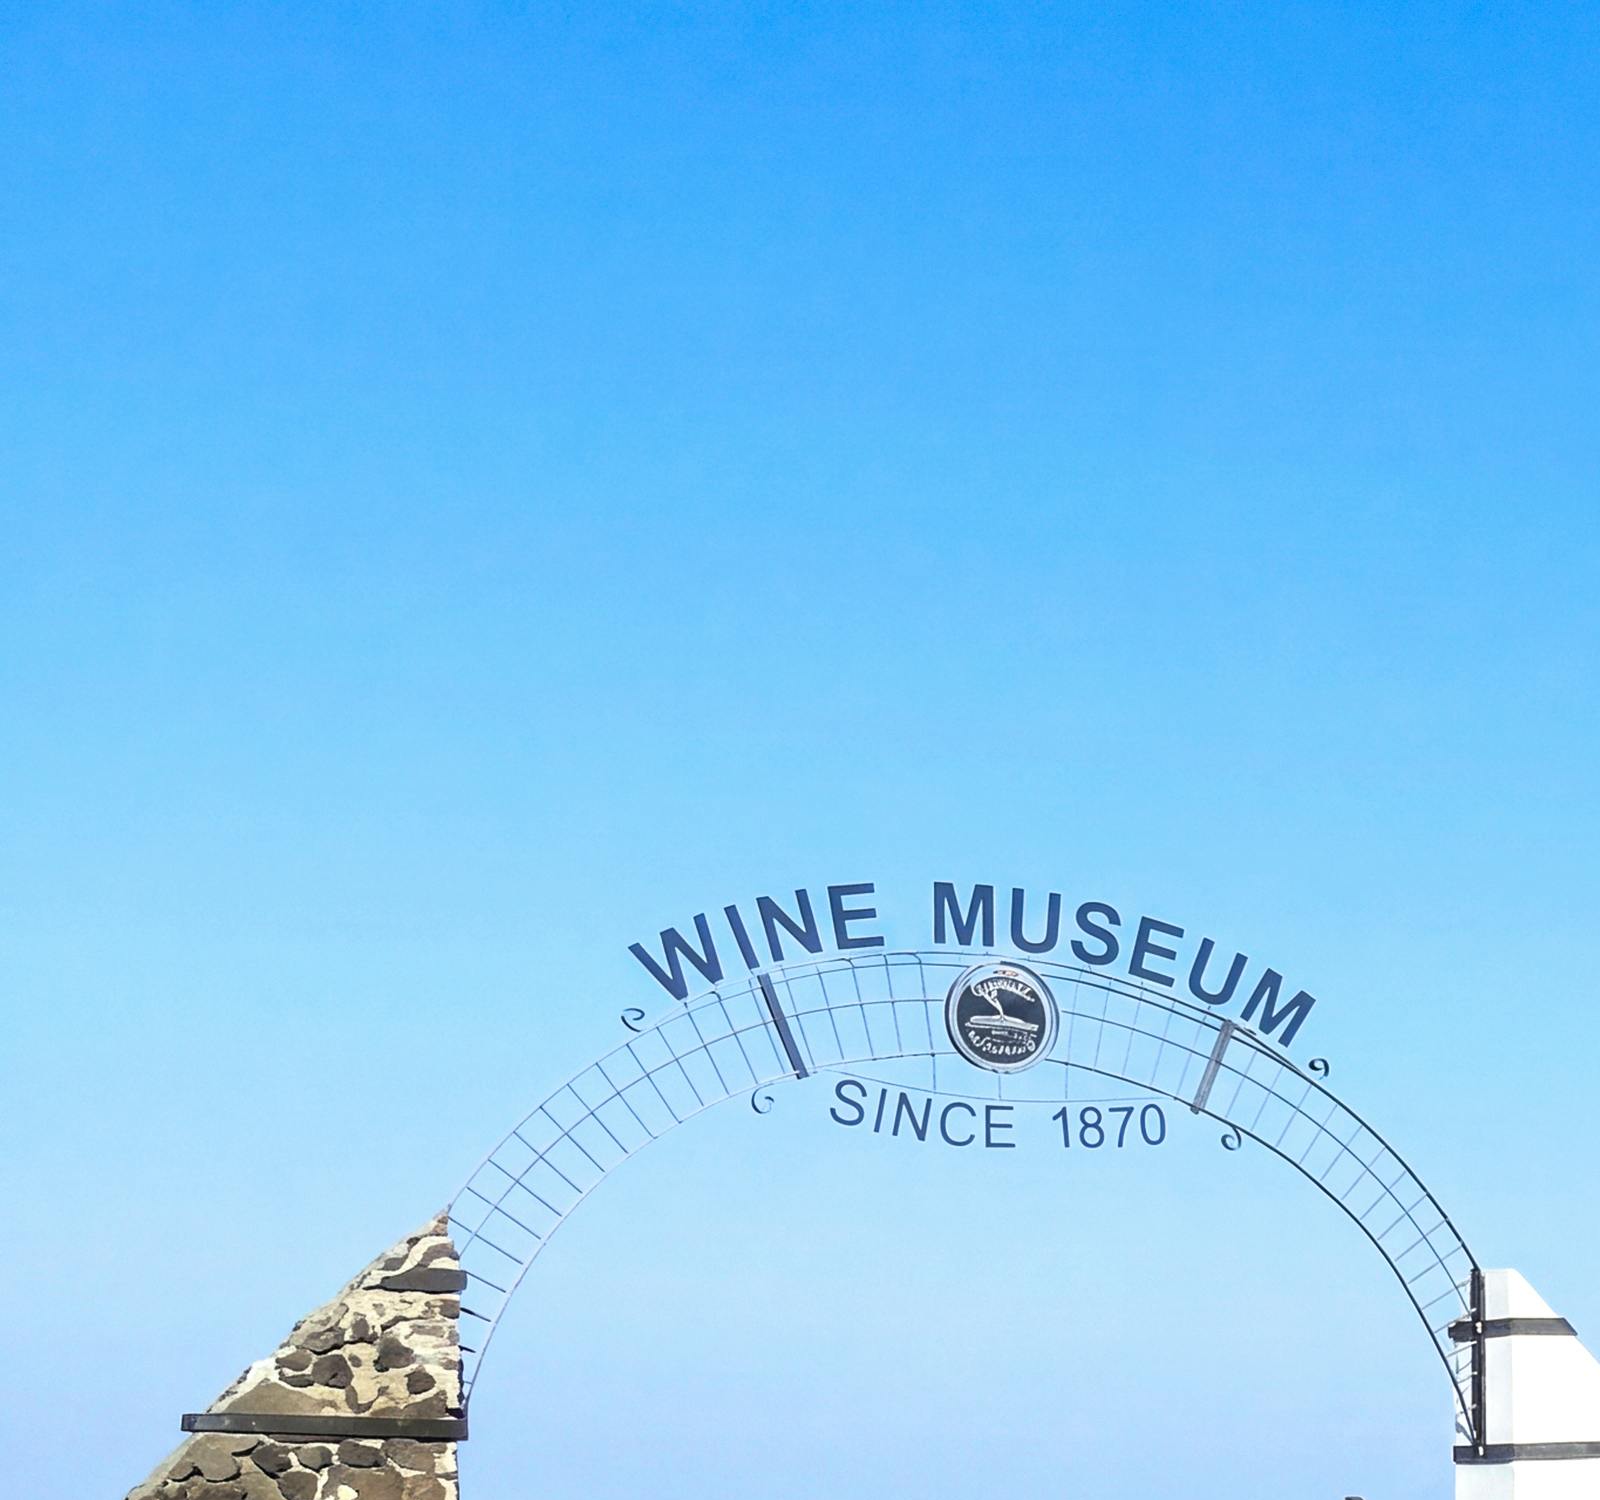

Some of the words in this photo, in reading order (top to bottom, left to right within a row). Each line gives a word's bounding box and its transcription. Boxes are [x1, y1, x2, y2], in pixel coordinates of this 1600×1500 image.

[628, 881, 886, 1001] WINE
[932, 881, 1317, 1048] MUSEUM
[828, 1078, 1016, 1149] SINCE
[1051, 1103, 1167, 1148] 1870
